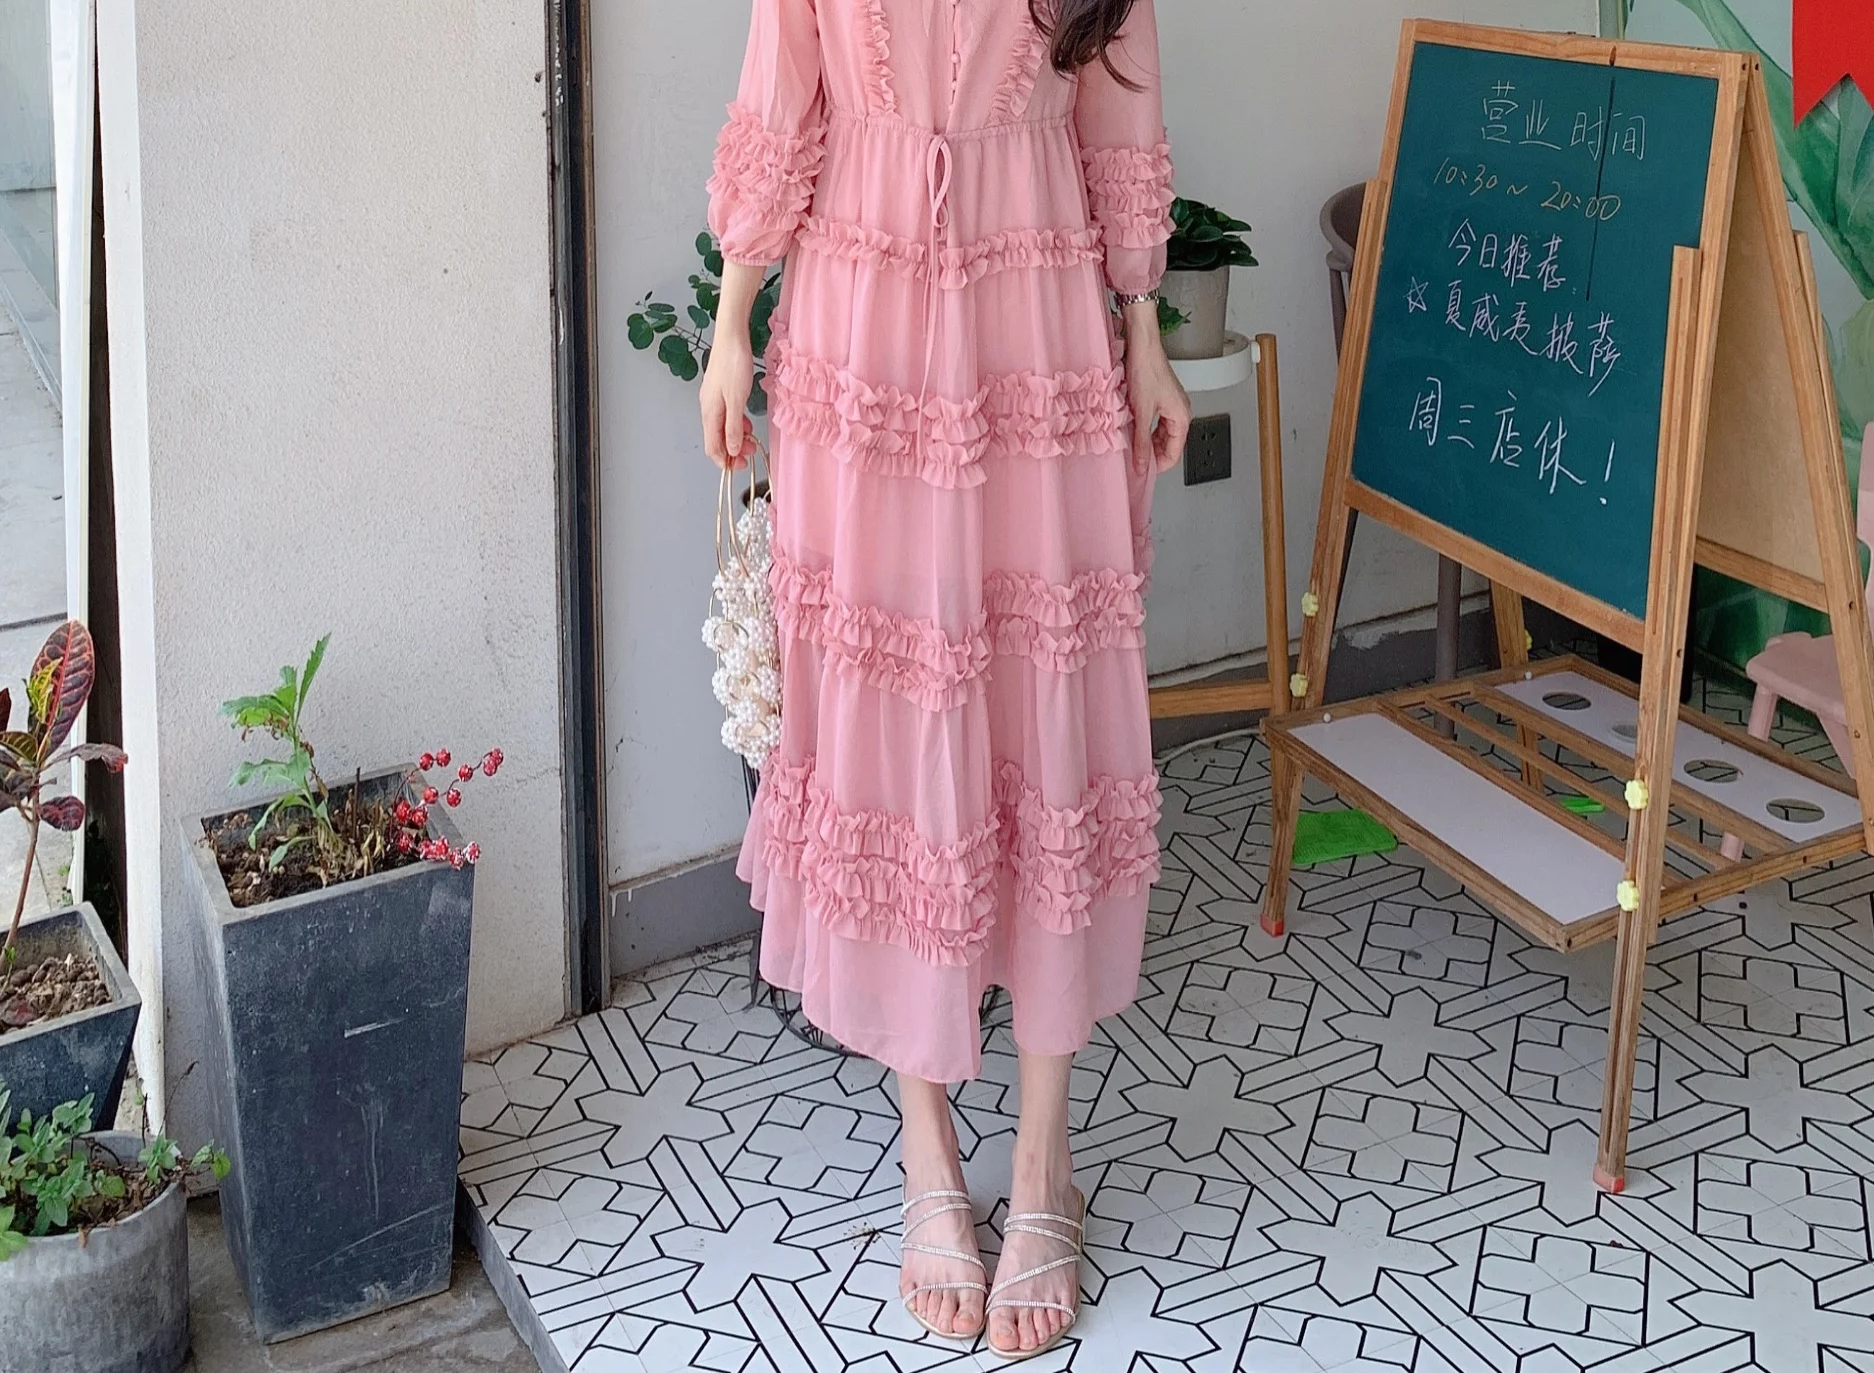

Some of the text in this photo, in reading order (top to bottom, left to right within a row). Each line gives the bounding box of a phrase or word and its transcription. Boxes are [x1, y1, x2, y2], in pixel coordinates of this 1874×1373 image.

[1481, 80, 1646, 161] 营业时间
[1445, 279, 1622, 398] 夏威夷披萨
